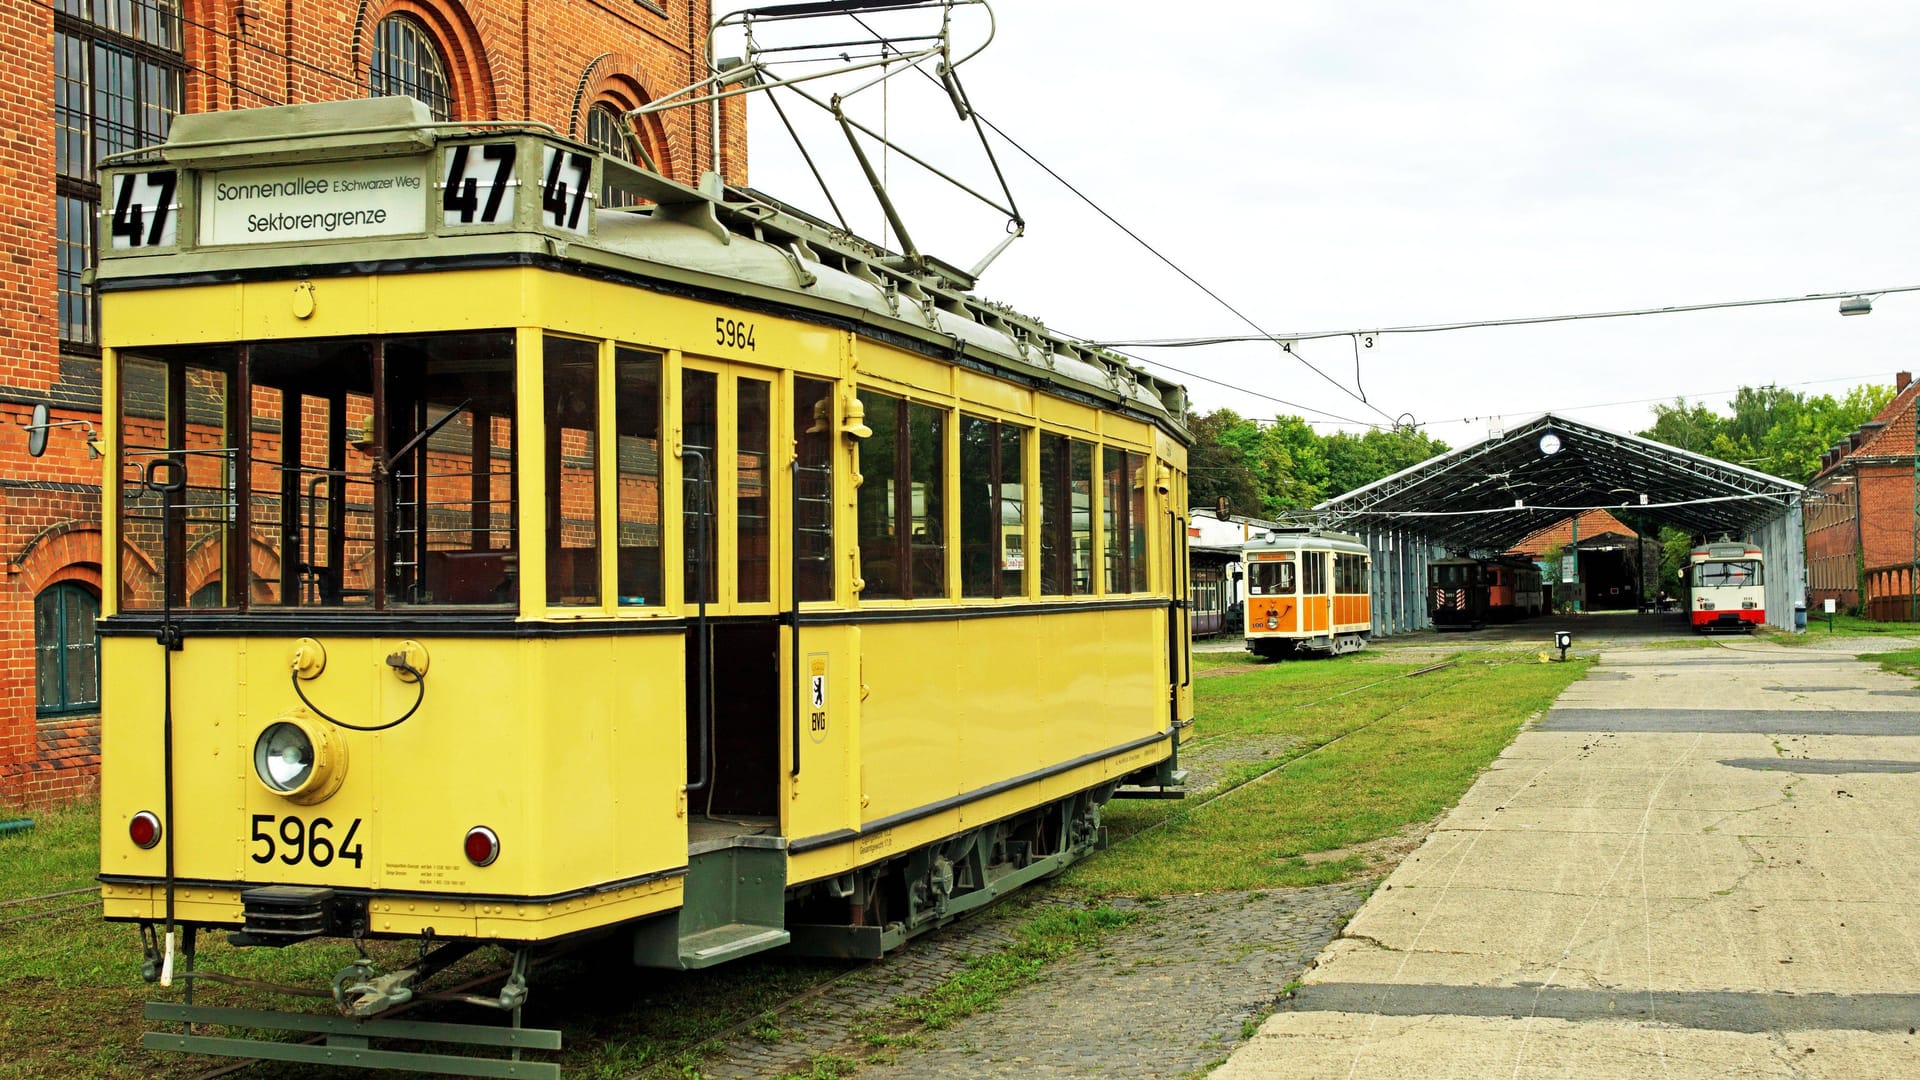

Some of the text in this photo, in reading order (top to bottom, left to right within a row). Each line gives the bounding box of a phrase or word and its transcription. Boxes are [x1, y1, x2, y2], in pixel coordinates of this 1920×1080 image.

[217, 177, 329, 201] Sonnenallee
[395, 175, 421, 189] Weg
[443, 144, 516, 223] 47
[543, 146, 592, 230] 47
[112, 171, 177, 246] 47
[247, 208, 387, 232] Sektorengrenze
[715, 316, 755, 352] 5964
[1283, 342, 1291, 353] 4
[1365, 337, 1373, 348] 3
[811, 711, 826, 732] BVG
[251, 814, 363, 869] 5964
